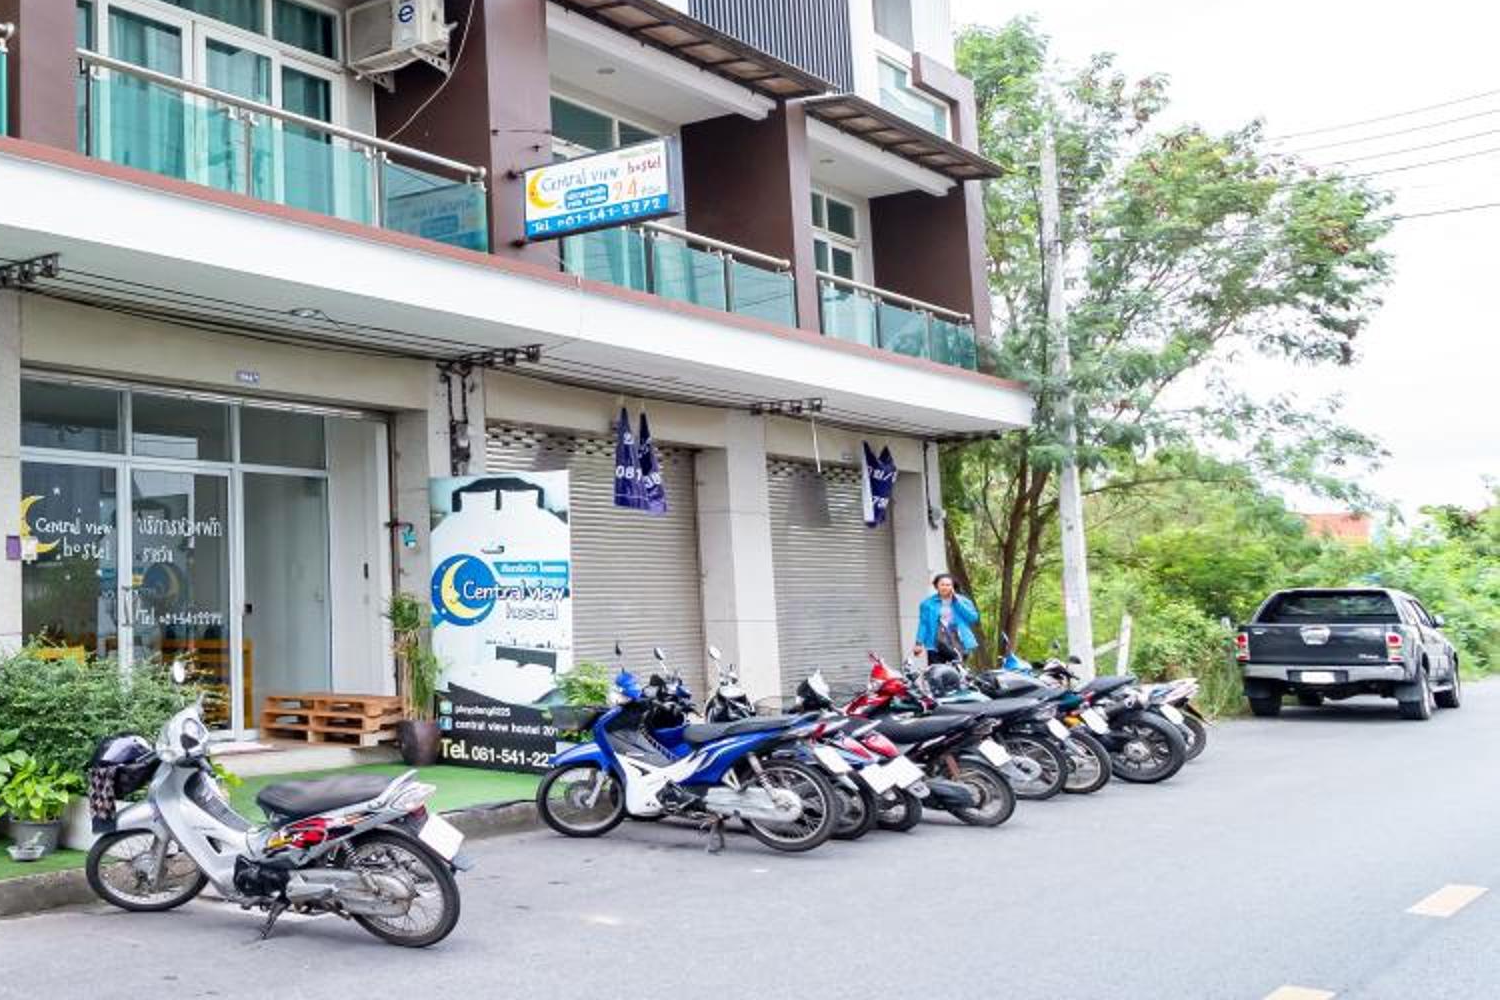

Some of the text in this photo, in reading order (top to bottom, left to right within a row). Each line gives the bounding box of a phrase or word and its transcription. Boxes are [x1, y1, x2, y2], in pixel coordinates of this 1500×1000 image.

[541, 166, 587, 193] Central
[628, 155, 662, 174] hostel
[35, 517, 112, 535] Central view
[63, 536, 110, 560] hostel
[463, 579, 565, 602] Central view
[505, 600, 558, 620] hostel
[455, 720, 486, 731] central
[488, 722, 509, 733] view
[511, 722, 540, 736] hostel
[440, 738, 469, 760] Tel.
